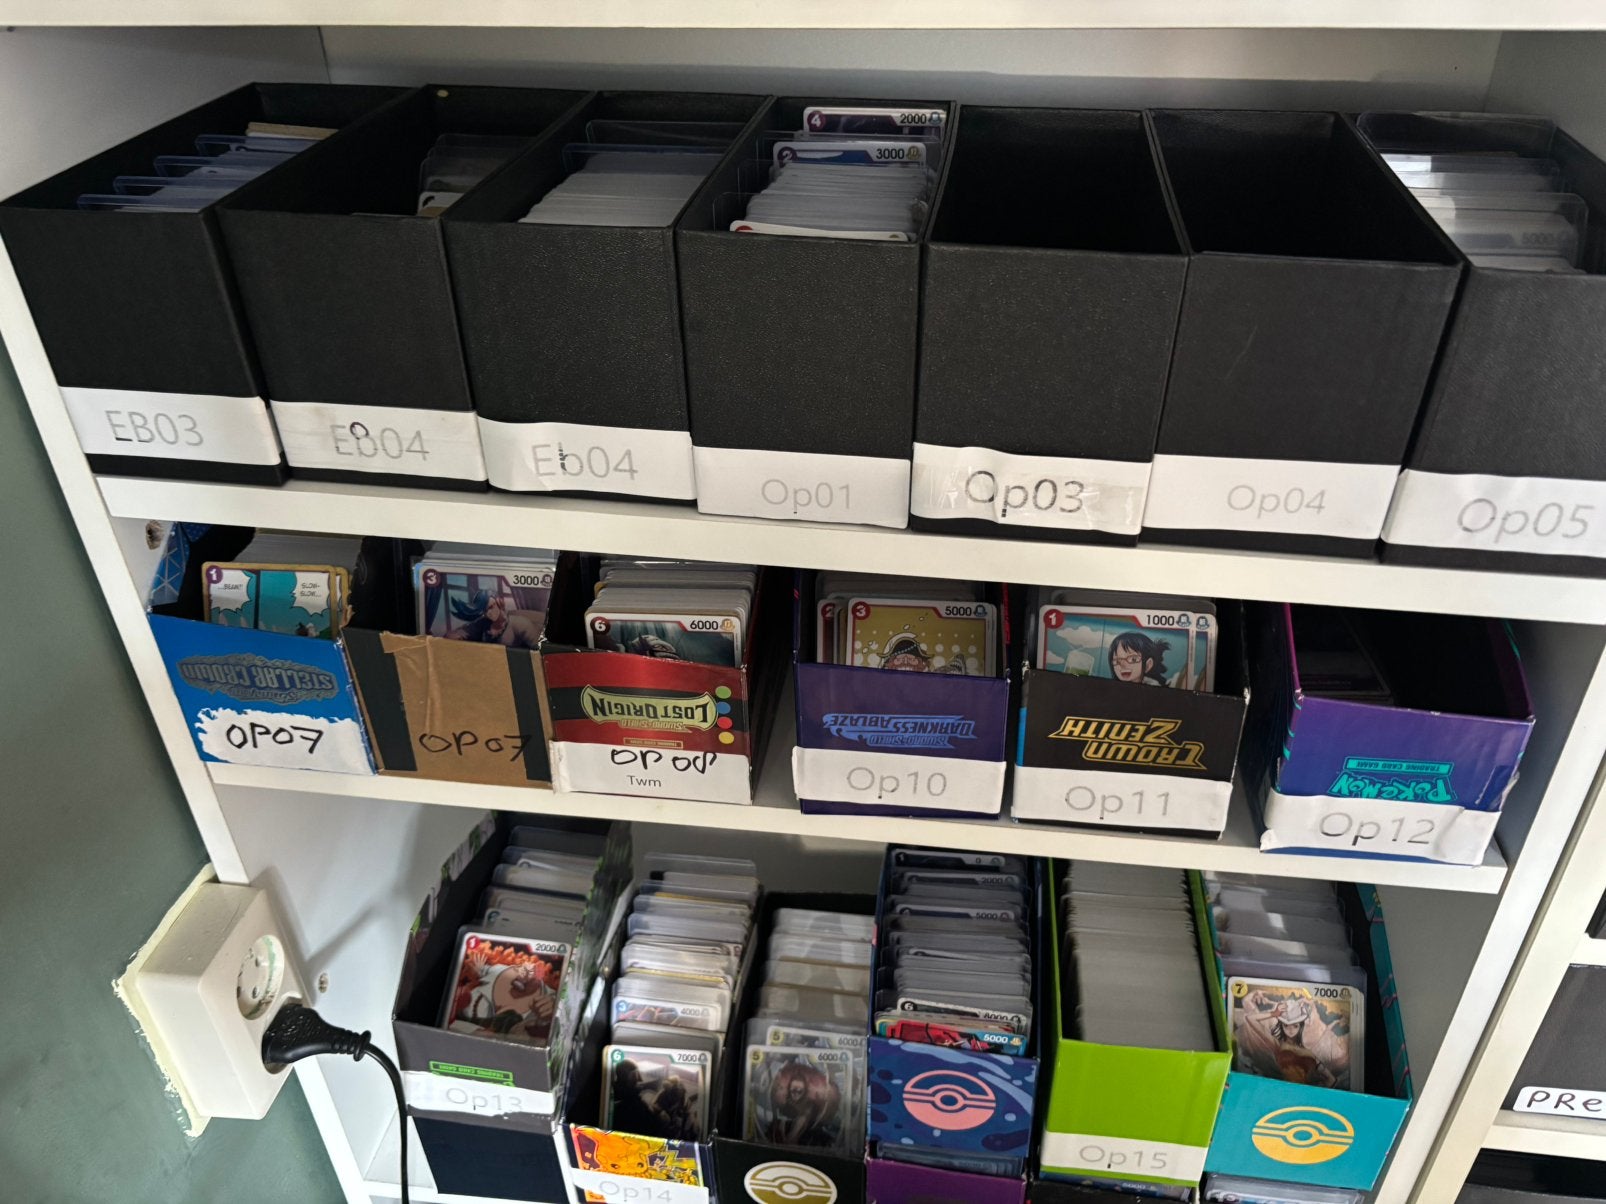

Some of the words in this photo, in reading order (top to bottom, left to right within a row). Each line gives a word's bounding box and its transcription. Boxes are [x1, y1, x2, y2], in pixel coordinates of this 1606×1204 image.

[810, 113, 821, 126] 4
[900, 113, 927, 125] 2000
[875, 148, 905, 160] 3000
[105, 409, 205, 447] EB03
[531, 441, 639, 481] Eb04
[761, 478, 852, 514] Op01
[964, 469, 1085, 518] Op03
[1227, 483, 1327, 518] Op04
[1457, 497, 1595, 544] Op05
[426, 572, 437, 585] 3
[512, 574, 540, 586] 3000
[855, 604, 867, 616] 3
[944, 605, 972, 617] 5000
[595, 619, 606, 631] 6
[689, 619, 719, 631] 6000
[1048, 613, 1058, 626] 1
[1146, 614, 1175, 626] 1000
[182, 663, 250, 686] CROWN
[252, 665, 333, 690] STELLAR
[588, 693, 660, 719] ORIGIN
[661, 701, 710, 723] LOST
[829, 715, 890, 728] ABLAZE
[892, 720, 974, 737] DARKNESS
[1062, 719, 1177, 743] ZENITH
[1085, 741, 1203, 767] CROWN
[626, 774, 662, 787] Twm
[846, 766, 948, 799] Op10
[1065, 785, 1171, 820] Op11
[1318, 811, 1436, 846] Op12
[535, 943, 556, 953] 2000
[1234, 983, 1244, 994] 7
[1313, 987, 1339, 998] 7000
[680, 1007, 700, 1016] 4000
[983, 1033, 1009, 1044] 5000
[677, 1053, 698, 1063] 7000
[817, 1051, 839, 1062] 6000
[1079, 1145, 1168, 1169] Op15
[599, 1180, 672, 1202] Op14
